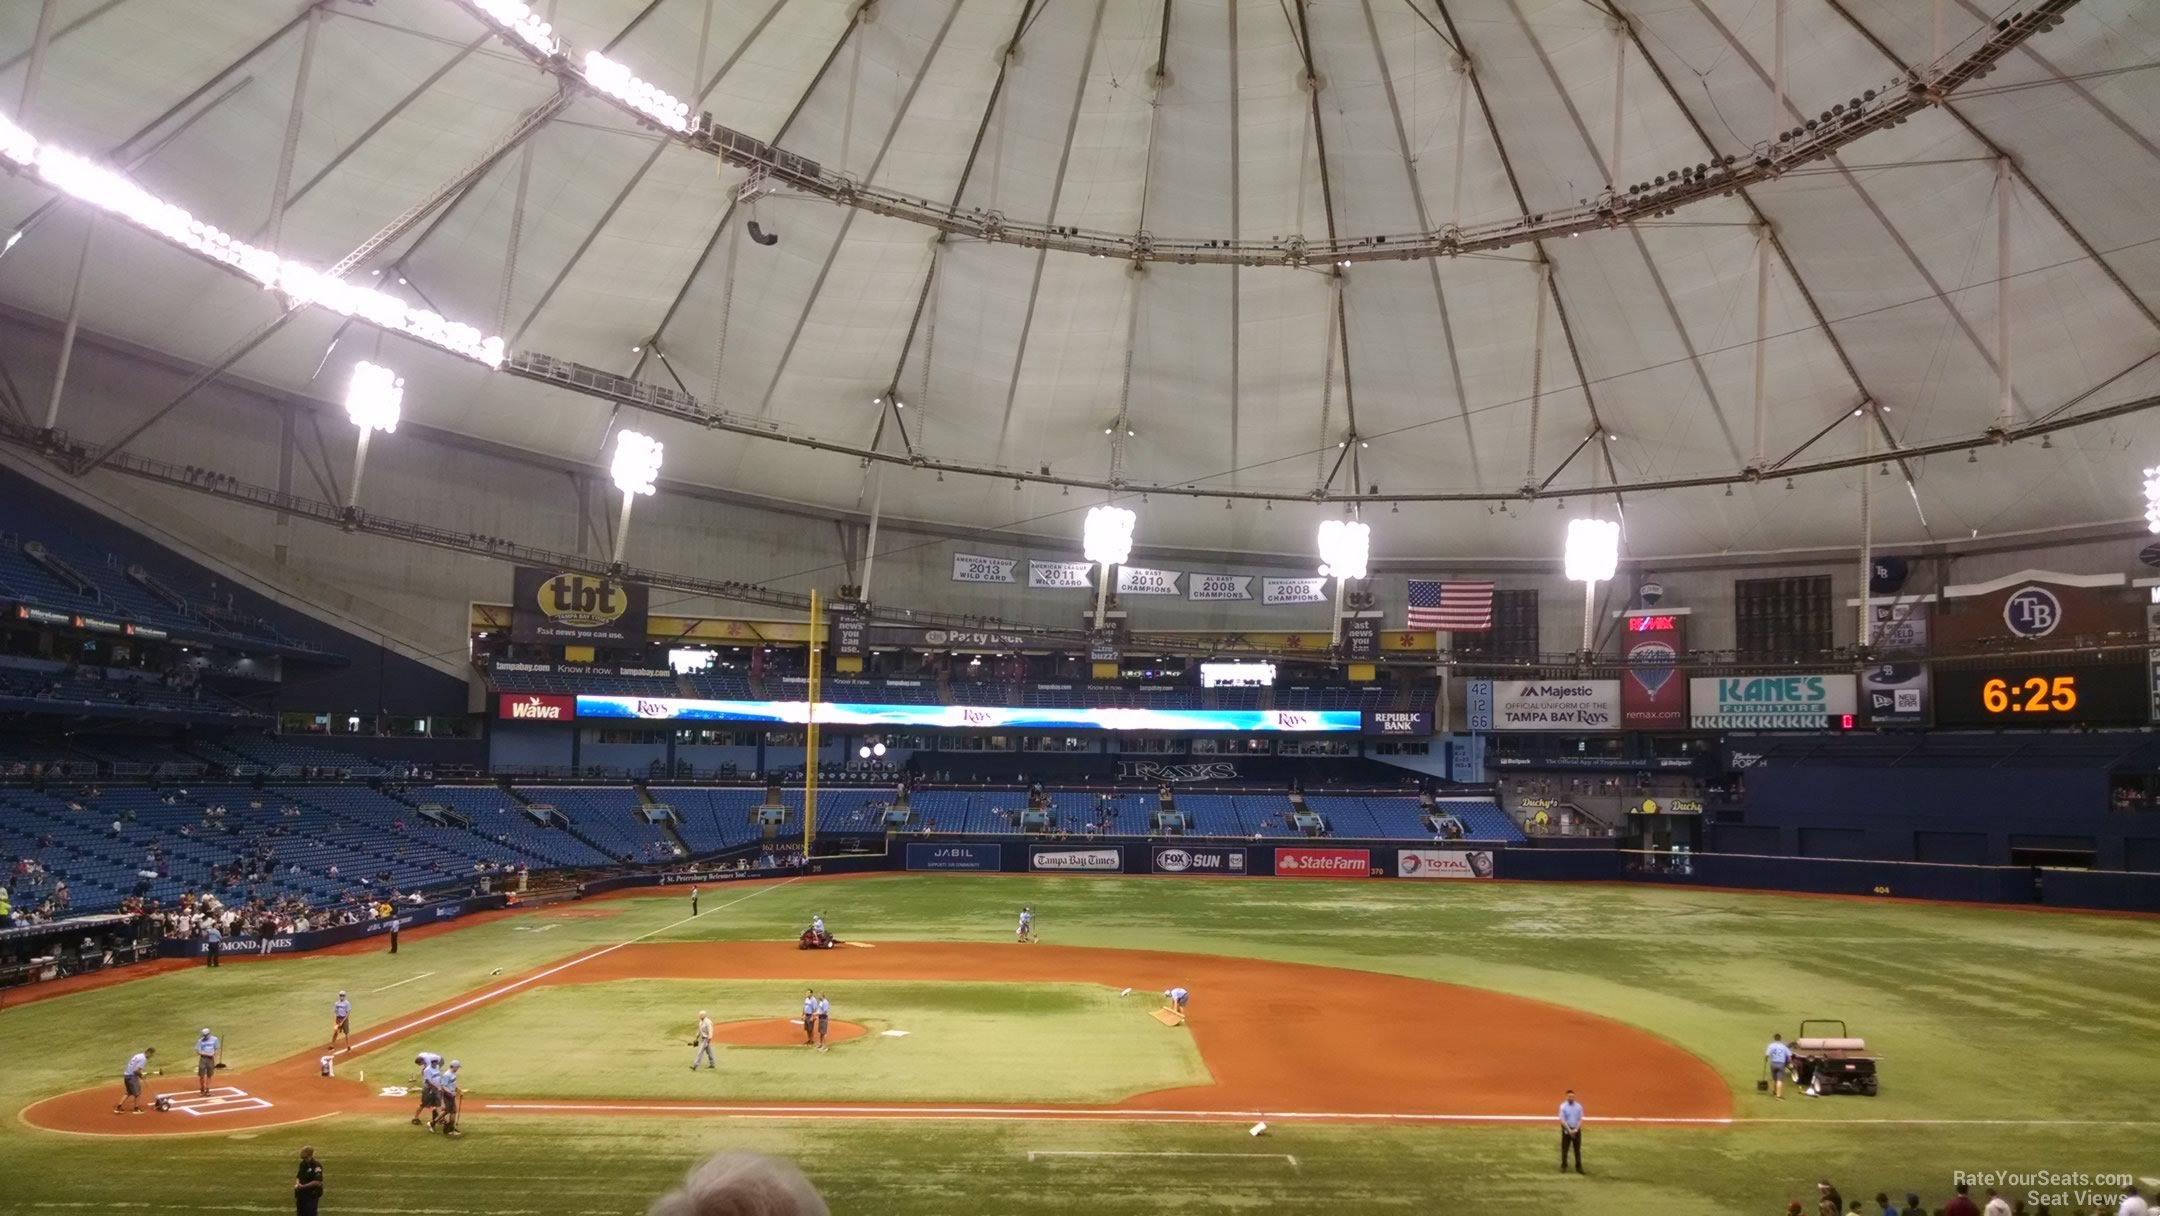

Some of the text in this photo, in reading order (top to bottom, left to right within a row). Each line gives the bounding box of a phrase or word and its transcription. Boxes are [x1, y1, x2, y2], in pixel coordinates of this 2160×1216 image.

[969, 563, 1000, 575] 2013
[1045, 569, 1074, 580] 2011
[1131, 575, 1163, 586] 2010
[1121, 584, 1171, 593] CHAMPIONS
[1203, 582, 1235, 592] 2008
[1277, 585, 1310, 595] 2008
[550, 576, 616, 613] tbt
[1267, 594, 1319, 602] CHAMPIONS
[2014, 597, 2052, 628] TB
[537, 627, 554, 635] Fast
[593, 630, 607, 638] can
[842, 630, 859, 639] you
[1352, 638, 1369, 646] you
[1091, 651, 1118, 660] buzz?
[496, 662, 670, 677] tampabay.com Know it now. tampabay.com
[1471, 684, 1487, 695] 42
[1541, 686, 1592, 699] Majestic
[1719, 677, 1825, 702] KANE'S
[1983, 677, 2077, 712] 6:25
[512, 702, 561, 718] Wawa
[1473, 700, 1486, 711] 12
[1375, 713, 1421, 722] REPUBLIC
[1505, 712, 1548, 722] TAMPA
[1551, 712, 1574, 722] BAY
[1626, 711, 1680, 719] remax.com
[1384, 721, 1412, 730] BANK
[1472, 716, 1487, 727] 66
[934, 848, 973, 857] JABIL
[1037, 855, 1115, 867] Tampa Bay Times
[1164, 854, 1184, 862] FOX
[1193, 854, 1220, 867] SUN
[1874, 886, 1890, 894] 404
